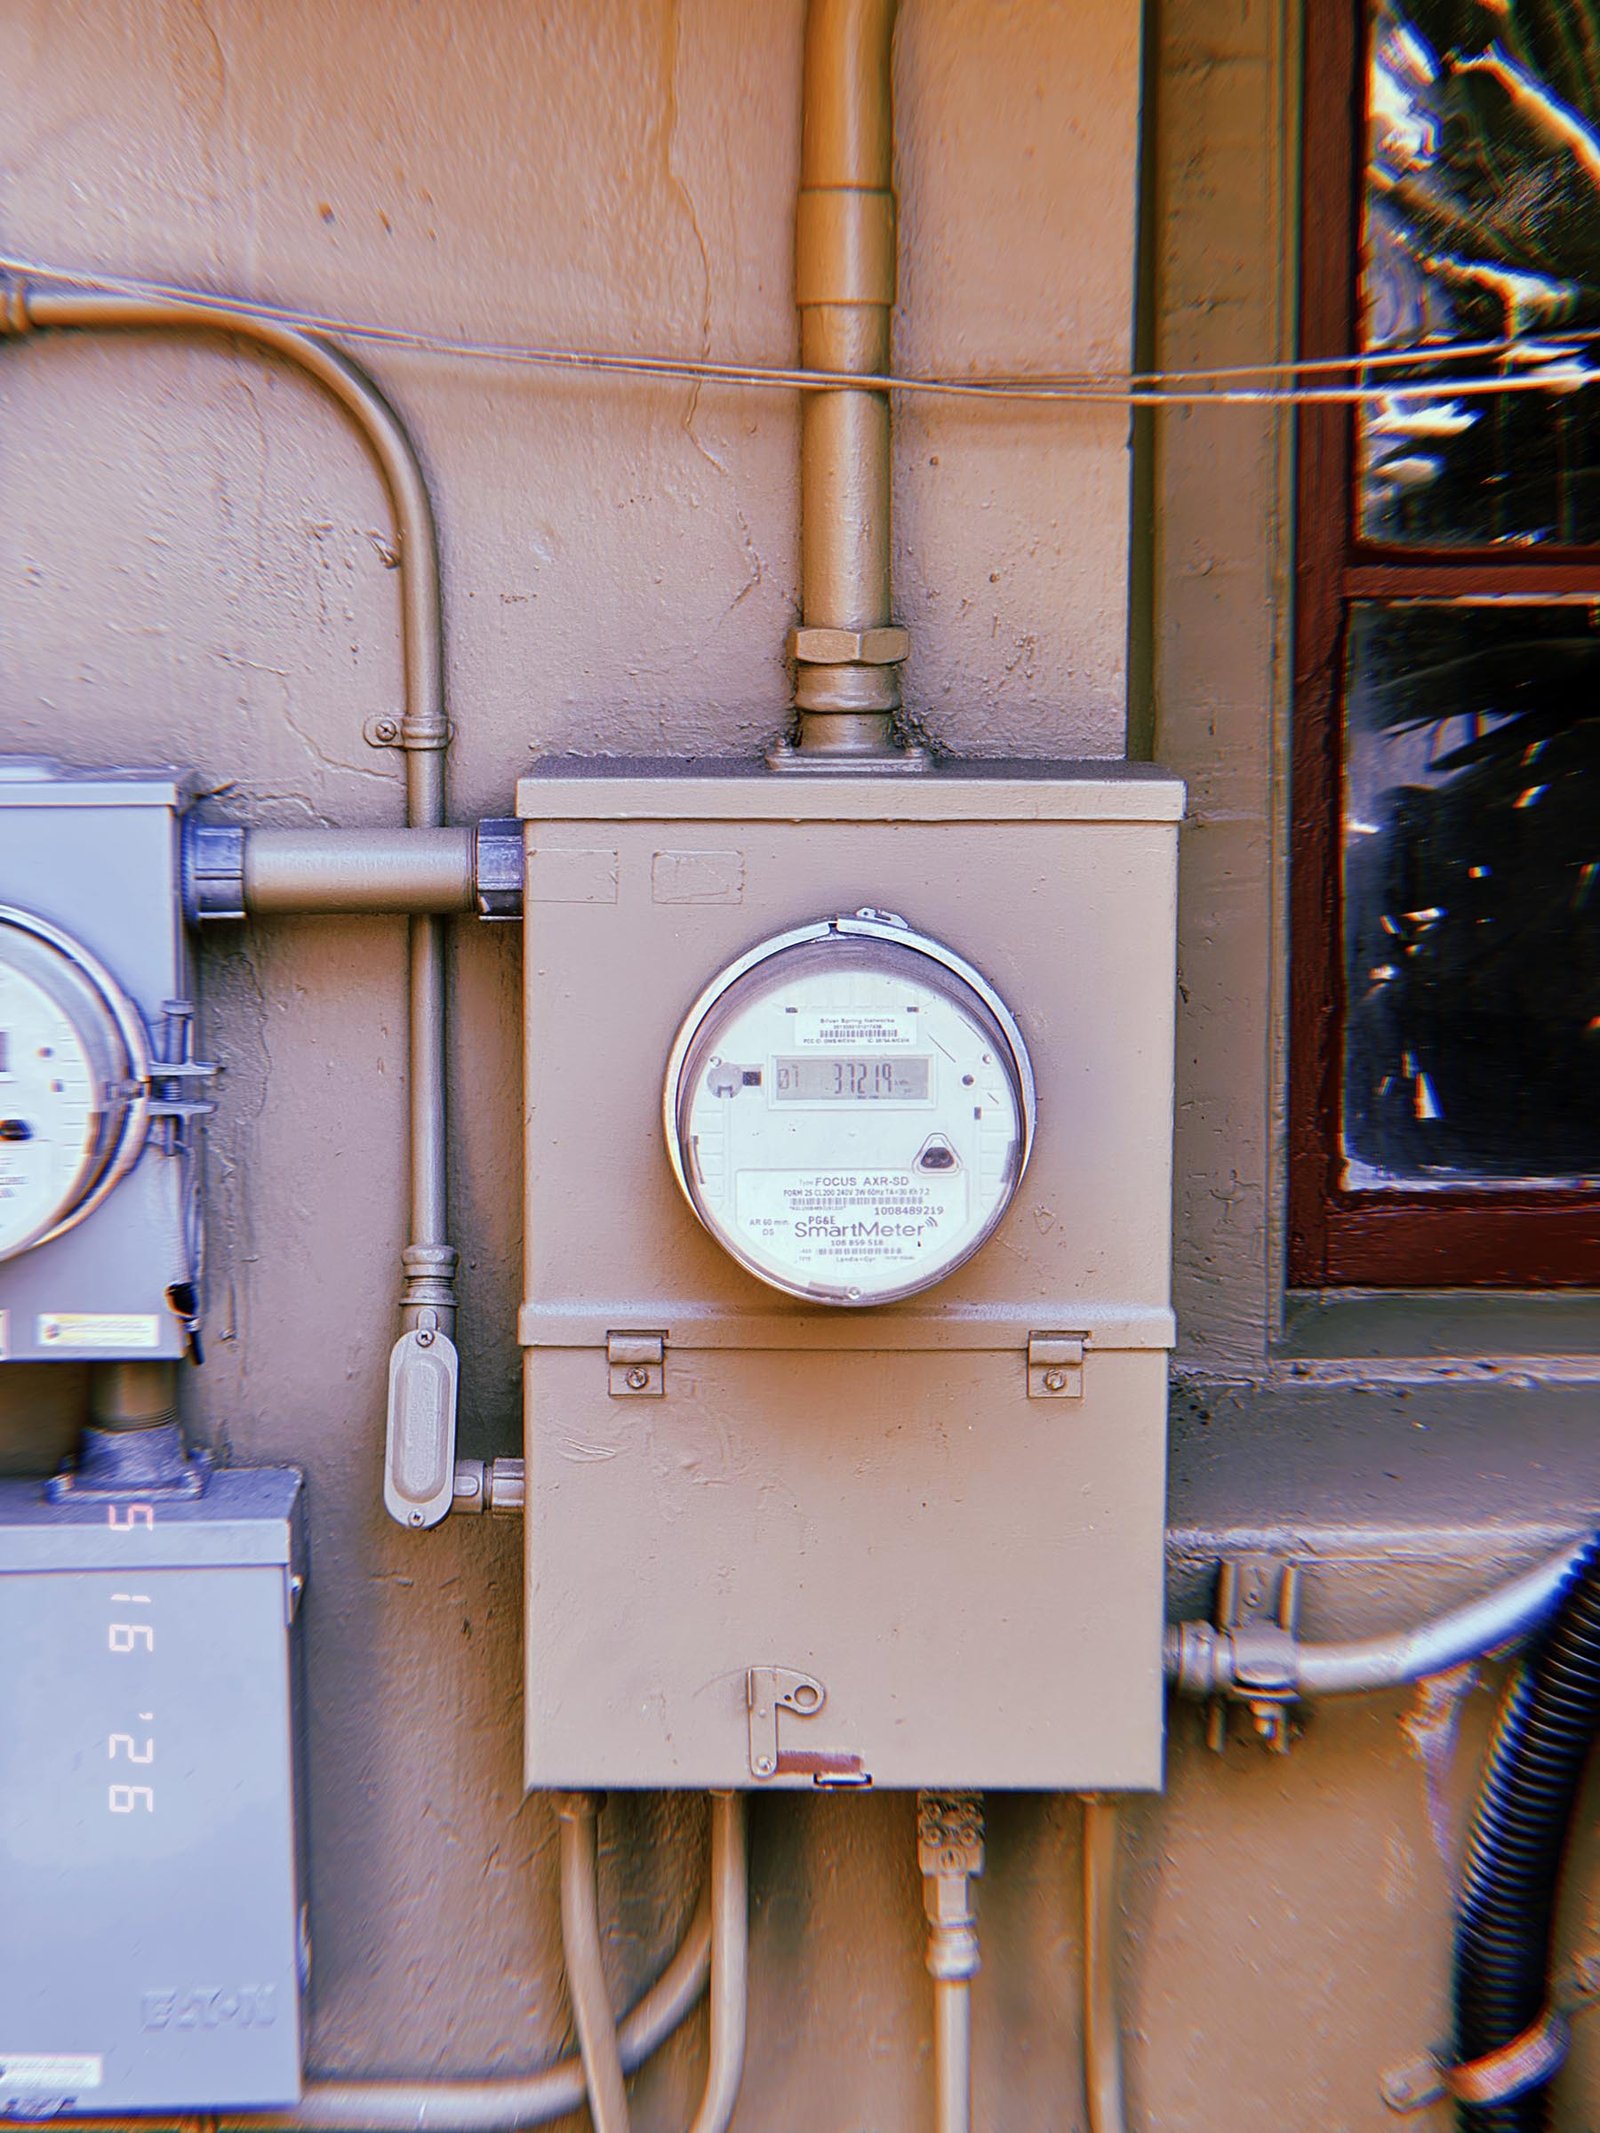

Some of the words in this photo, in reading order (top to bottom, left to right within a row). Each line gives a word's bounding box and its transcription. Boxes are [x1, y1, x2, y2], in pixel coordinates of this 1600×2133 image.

[834, 1063, 892, 1094] 37219
[815, 1176, 857, 1186] FOCUS
[863, 1176, 909, 1186] AXR-SD
[783, 1189, 803, 1197] FORM
[815, 1189, 835, 1197] CL200
[874, 1206, 944, 1216] 1008489219
[808, 1215, 836, 1225] PG&E
[794, 1220, 925, 1238] SmartMeter
